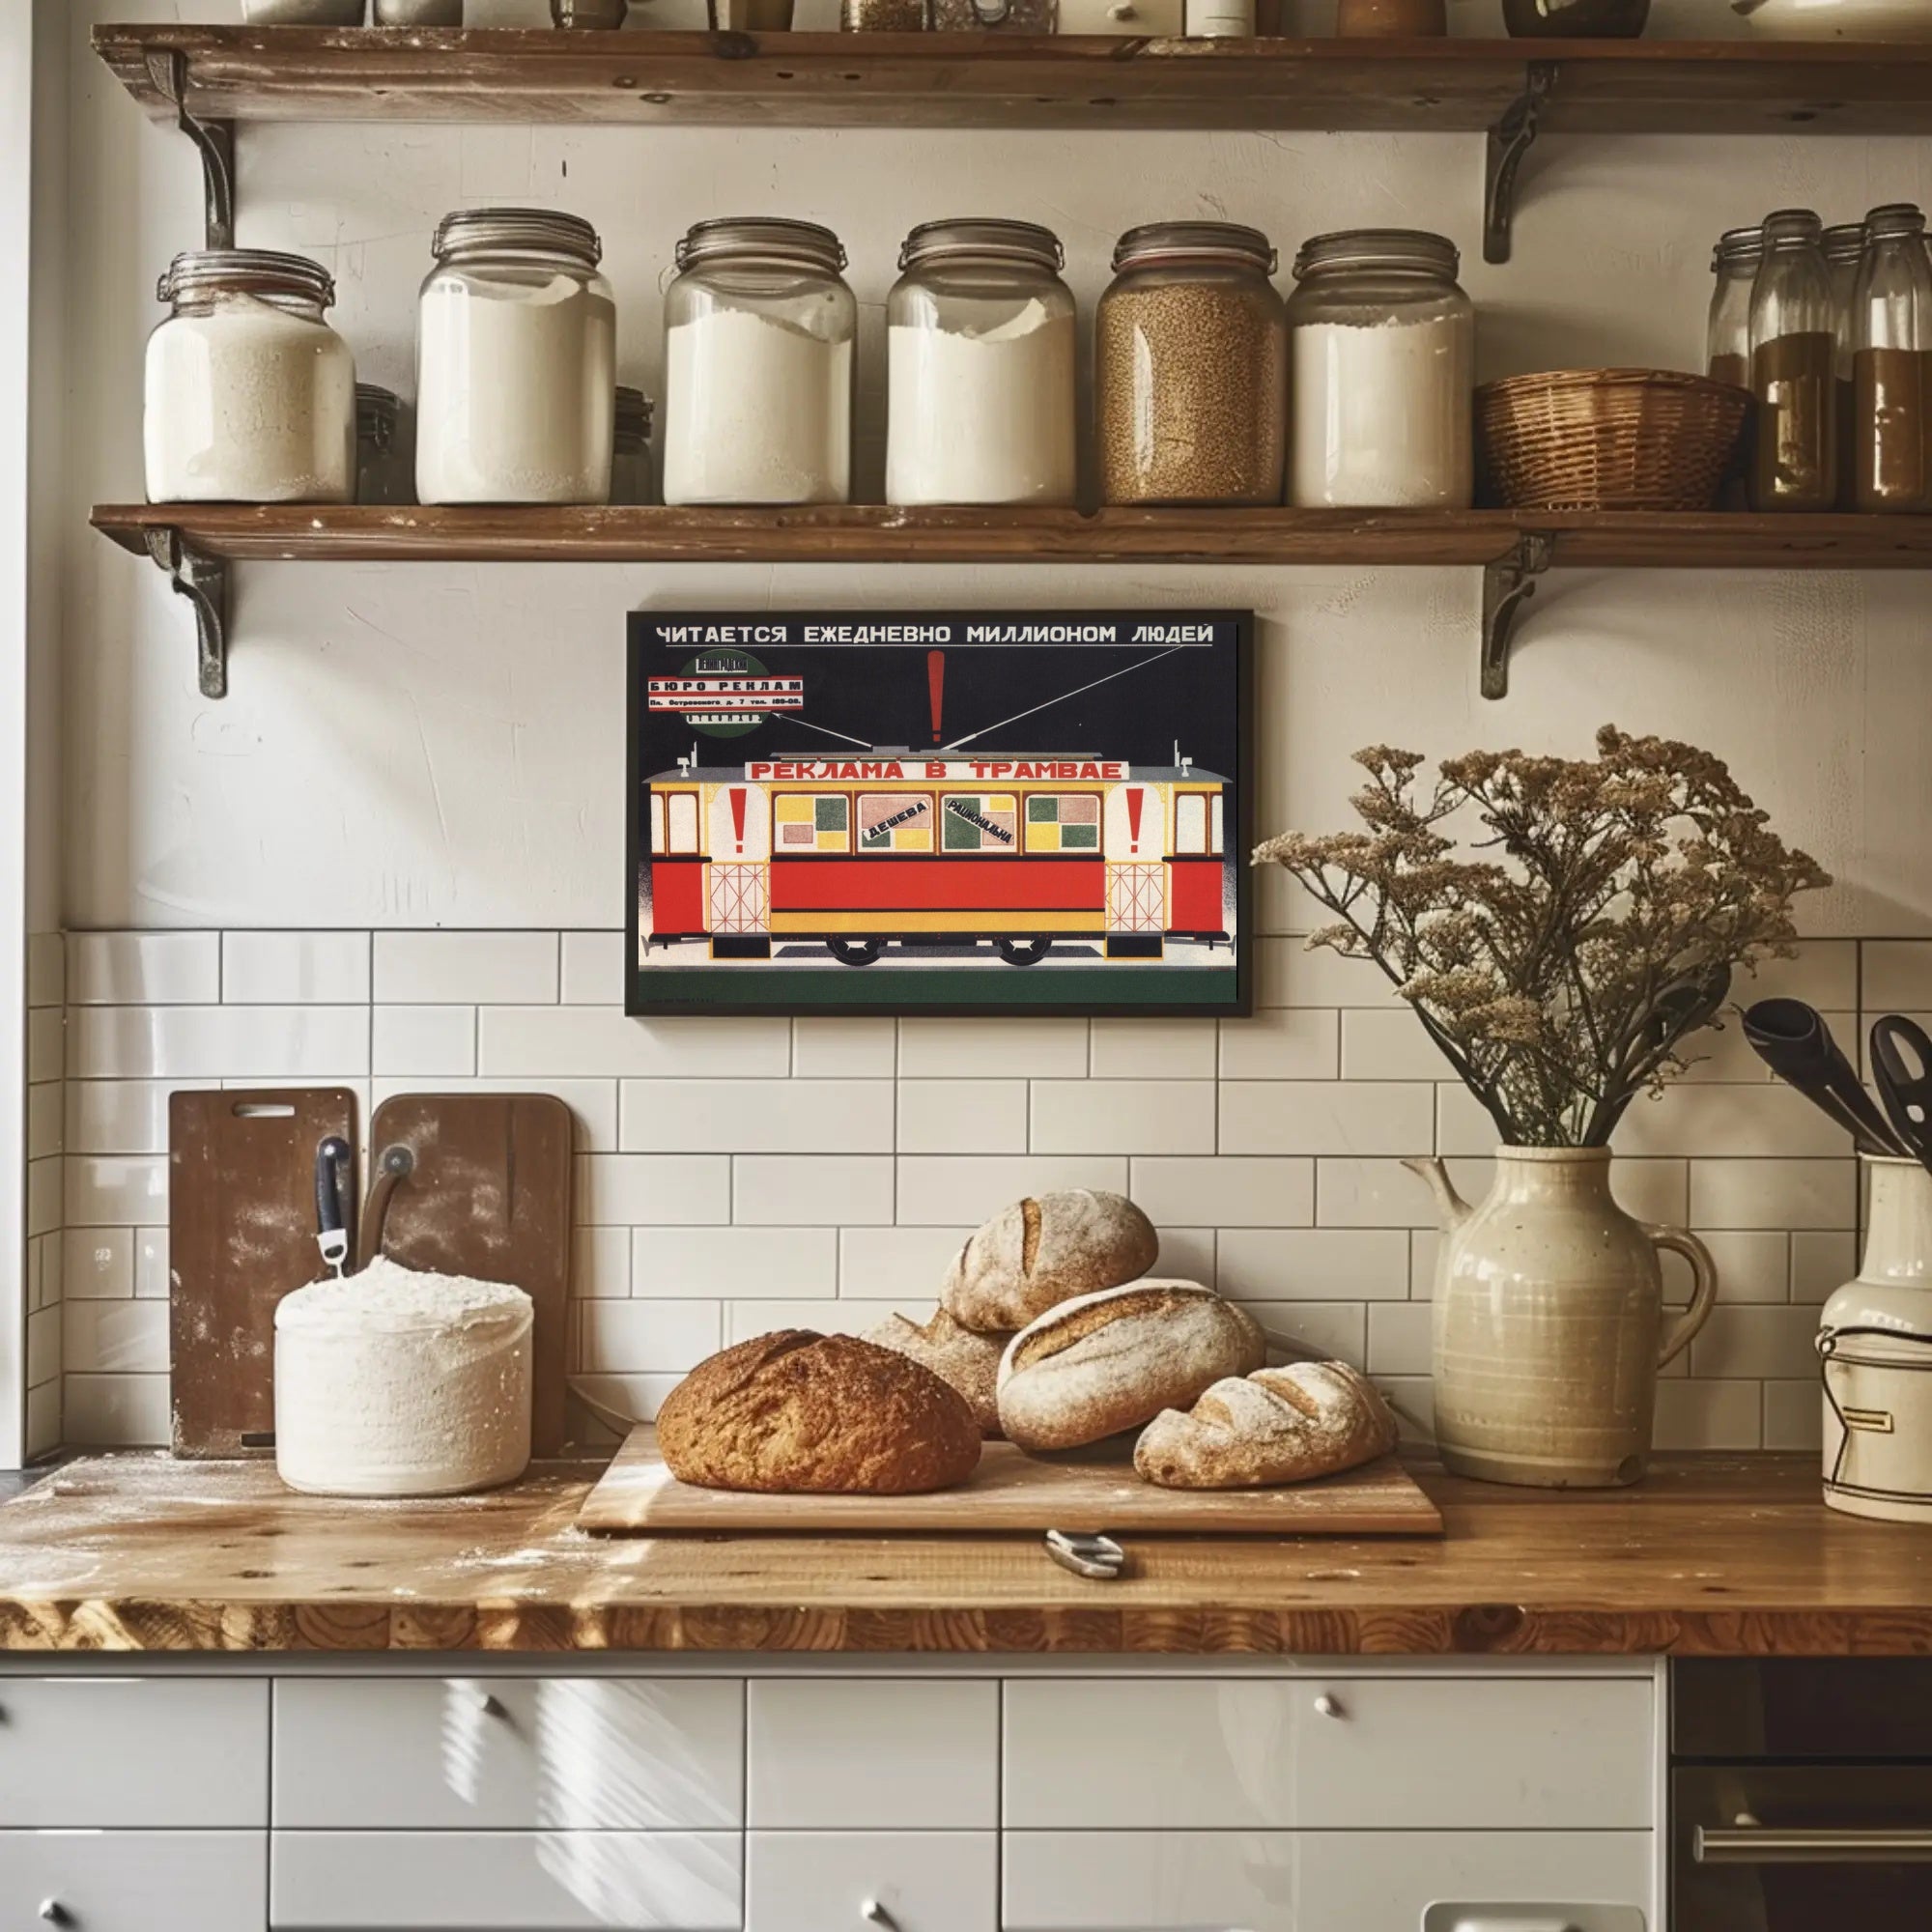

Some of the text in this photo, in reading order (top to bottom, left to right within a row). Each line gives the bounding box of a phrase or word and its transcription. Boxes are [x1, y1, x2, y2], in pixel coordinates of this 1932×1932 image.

[656, 623, 1213, 643] ЧИТАЕТСЯ ЕЖЕДНЕВНО МИЛЛИОНОМ ЛЮДЕЙ
[650, 681, 706, 692] БЮРО
[751, 762, 1122, 780] РЕКЛАМА В ТРАМВАЕ
[868, 802, 927, 838] ДЕШЕВА
[947, 800, 1013, 844] РАЦИОНАЛЬНА
